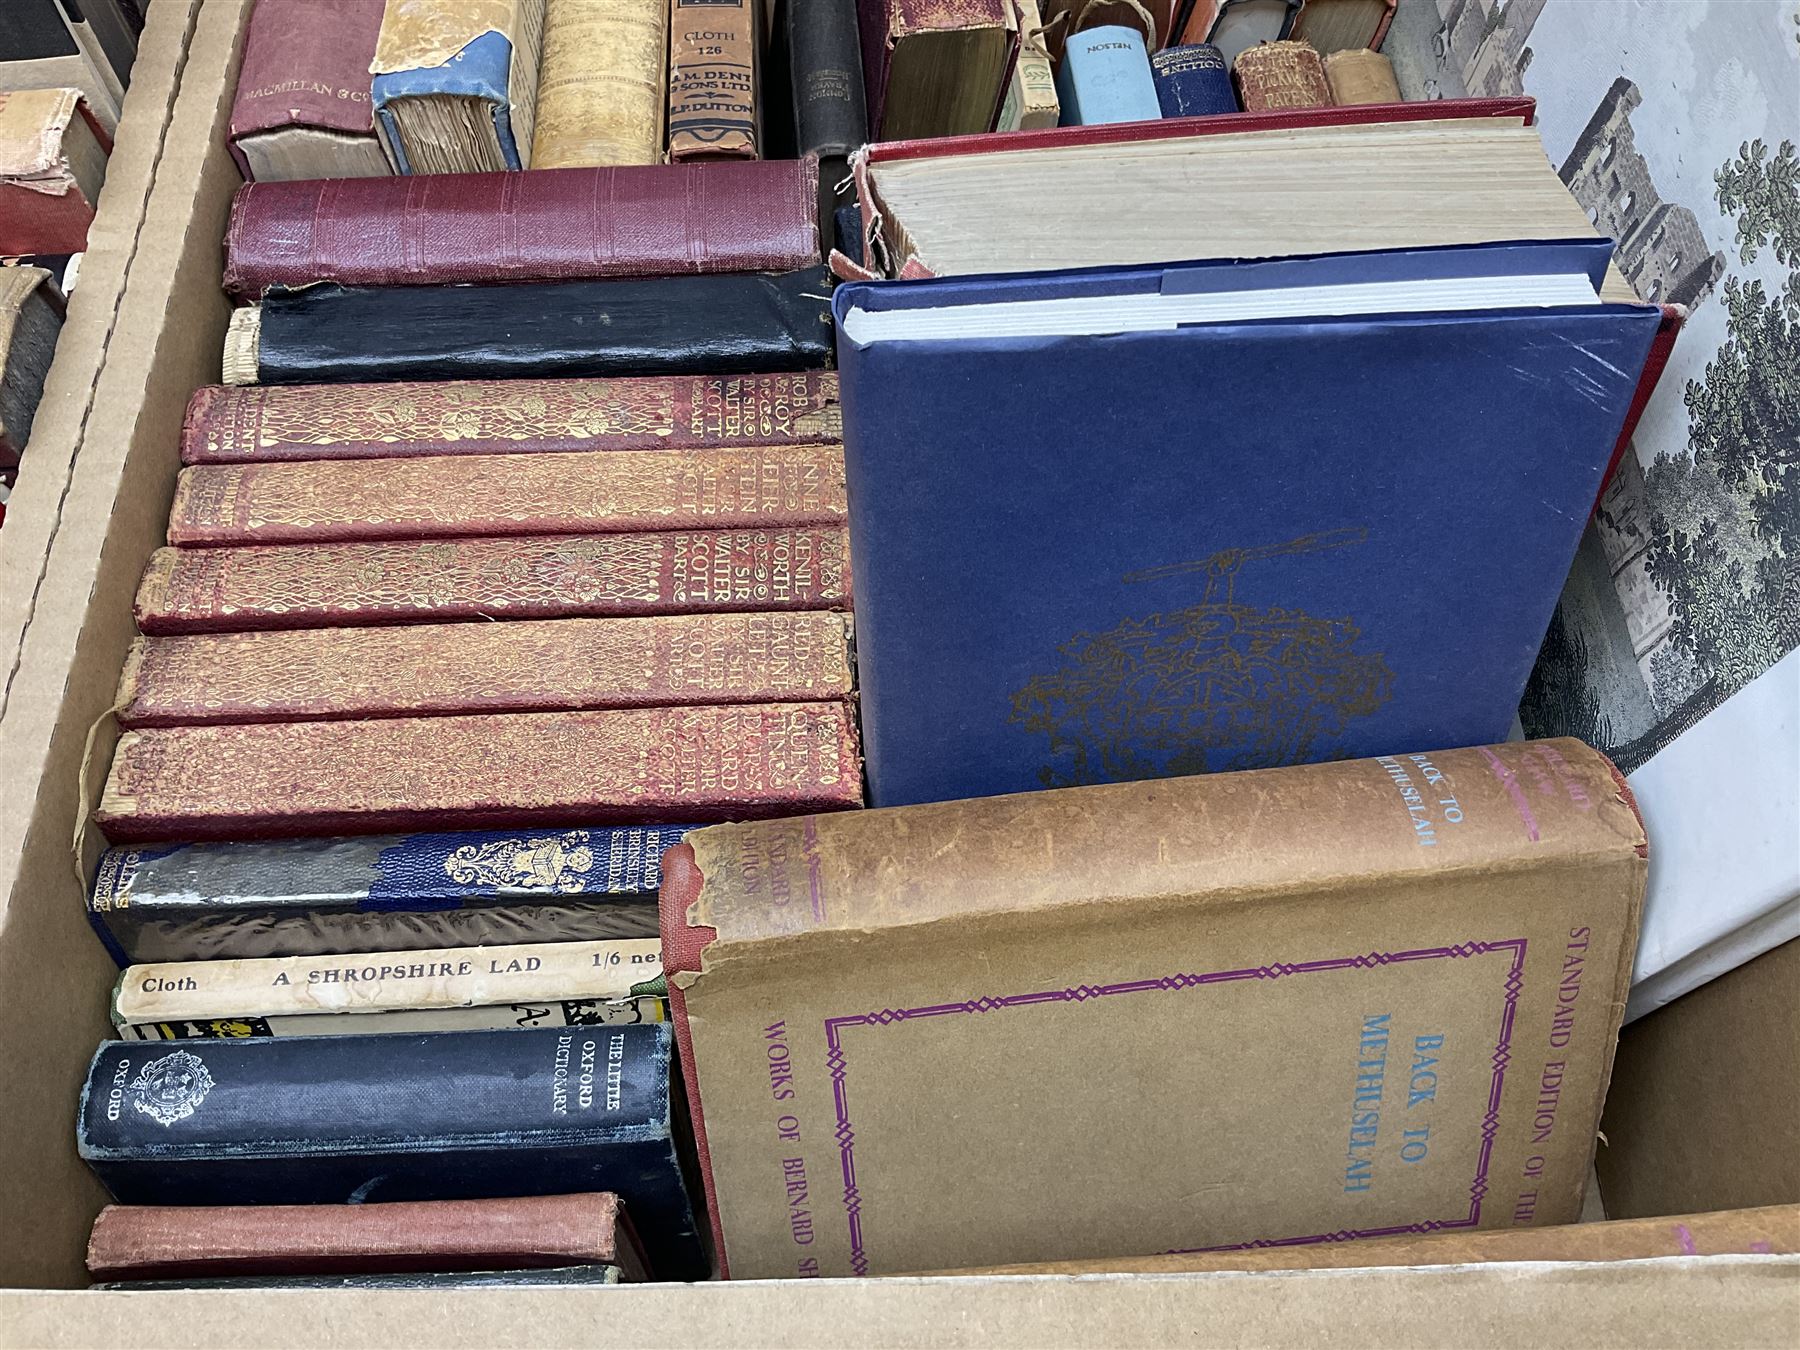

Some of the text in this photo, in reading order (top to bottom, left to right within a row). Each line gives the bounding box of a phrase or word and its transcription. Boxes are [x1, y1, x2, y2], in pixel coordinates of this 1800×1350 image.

[684, 31, 735, 41] CLOTH
[698, 46, 722, 55] 126
[1087, 42, 1132, 53] NELSON
[1161, 60, 1224, 76] COLLINS
[337, 88, 348, 99] &
[680, 81, 719, 91] SONS
[707, 380, 722, 438] SCOTT
[726, 380, 740, 438] WALTER
[744, 397, 756, 422] SIR
[775, 395, 790, 437] ROY
[792, 375, 808, 407] ROB
[801, 450, 820, 511] ANNE
[690, 534, 709, 601] SCOTT
[714, 535, 731, 601] WALTER
[735, 535, 749, 600] BY SIR
[773, 534, 789, 601] WORTH
[795, 533, 811, 600] KENIL-
[687, 618, 706, 688] SCOTT
[659, 718, 677, 795] SCOTT
[680, 715, 697, 794] WALTER
[700, 716, 717, 790] BY SIR
[720, 717, 739, 790] WARD
[1409, 754, 1464, 823] BACK TO
[608, 831, 624, 894] SHERIDAN
[626, 830, 642, 893] BRINSLEY
[644, 831, 660, 889] RICHARD
[142, 977, 197, 992] Cloth
[272, 957, 541, 986] A SHROPSHIRE LAD
[591, 951, 621, 967] 1/6
[1549, 926, 1591, 1048] STANDARD
[107, 1059, 130, 1121] OXFORD
[553, 1036, 573, 1114] DICTIONARY
[579, 1040, 596, 1108] OXFORD
[607, 1034, 624, 1110] THE LITTLE
[763, 1020, 795, 1100] WORKS
[777, 1115, 800, 1142] OF
[1343, 1012, 1392, 1192] METHUSELAH
[1400, 1033, 1445, 1163] BACK TO
[1530, 1060, 1566, 1145] EDITION
[782, 1156, 814, 1245] BERNARD
